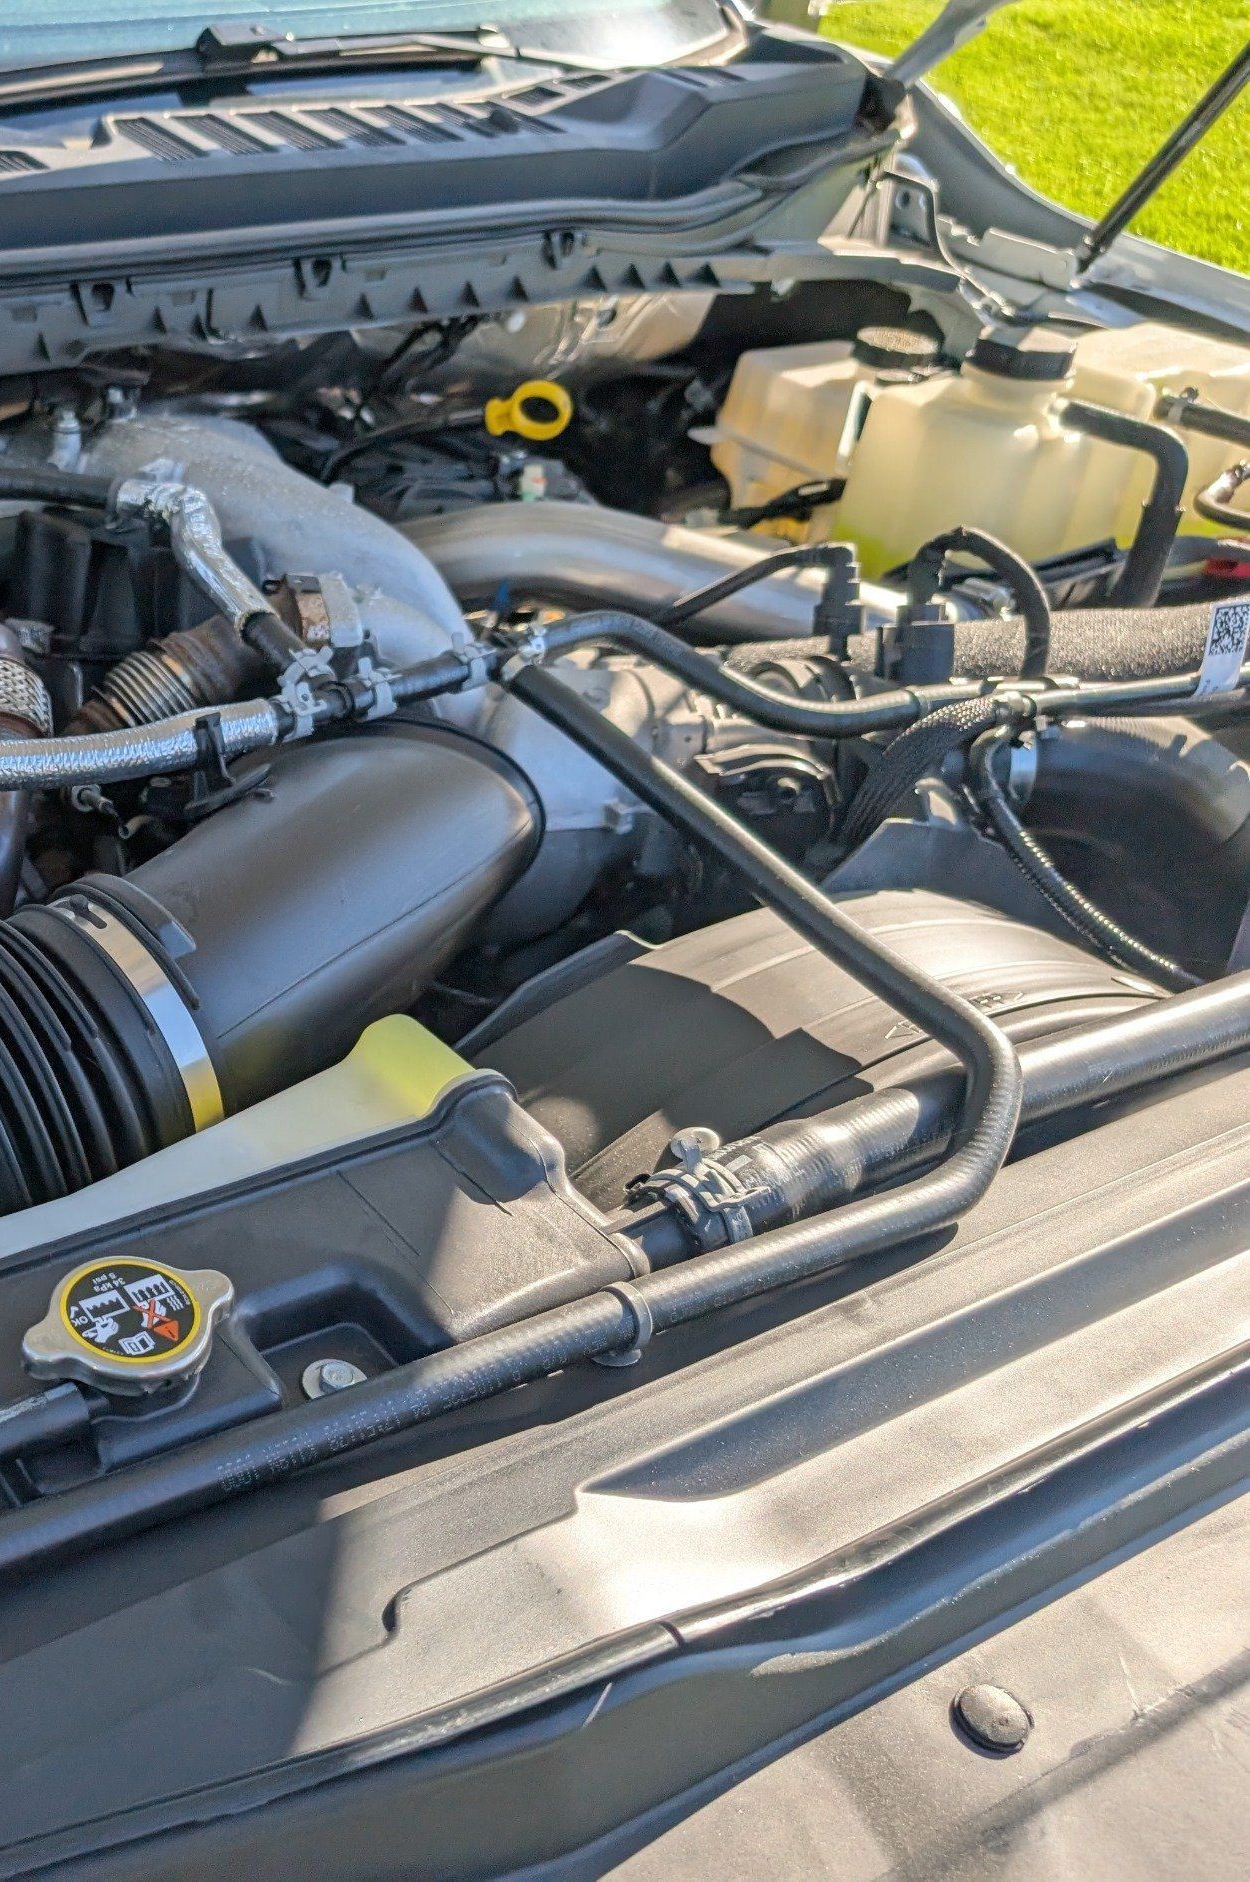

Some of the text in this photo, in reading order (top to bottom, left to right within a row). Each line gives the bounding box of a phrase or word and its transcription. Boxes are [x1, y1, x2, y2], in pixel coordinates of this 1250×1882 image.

[92, 1272, 108, 1285] psi
[93, 1276, 126, 1293] 34 kPa
[71, 1315, 90, 1327] OK
